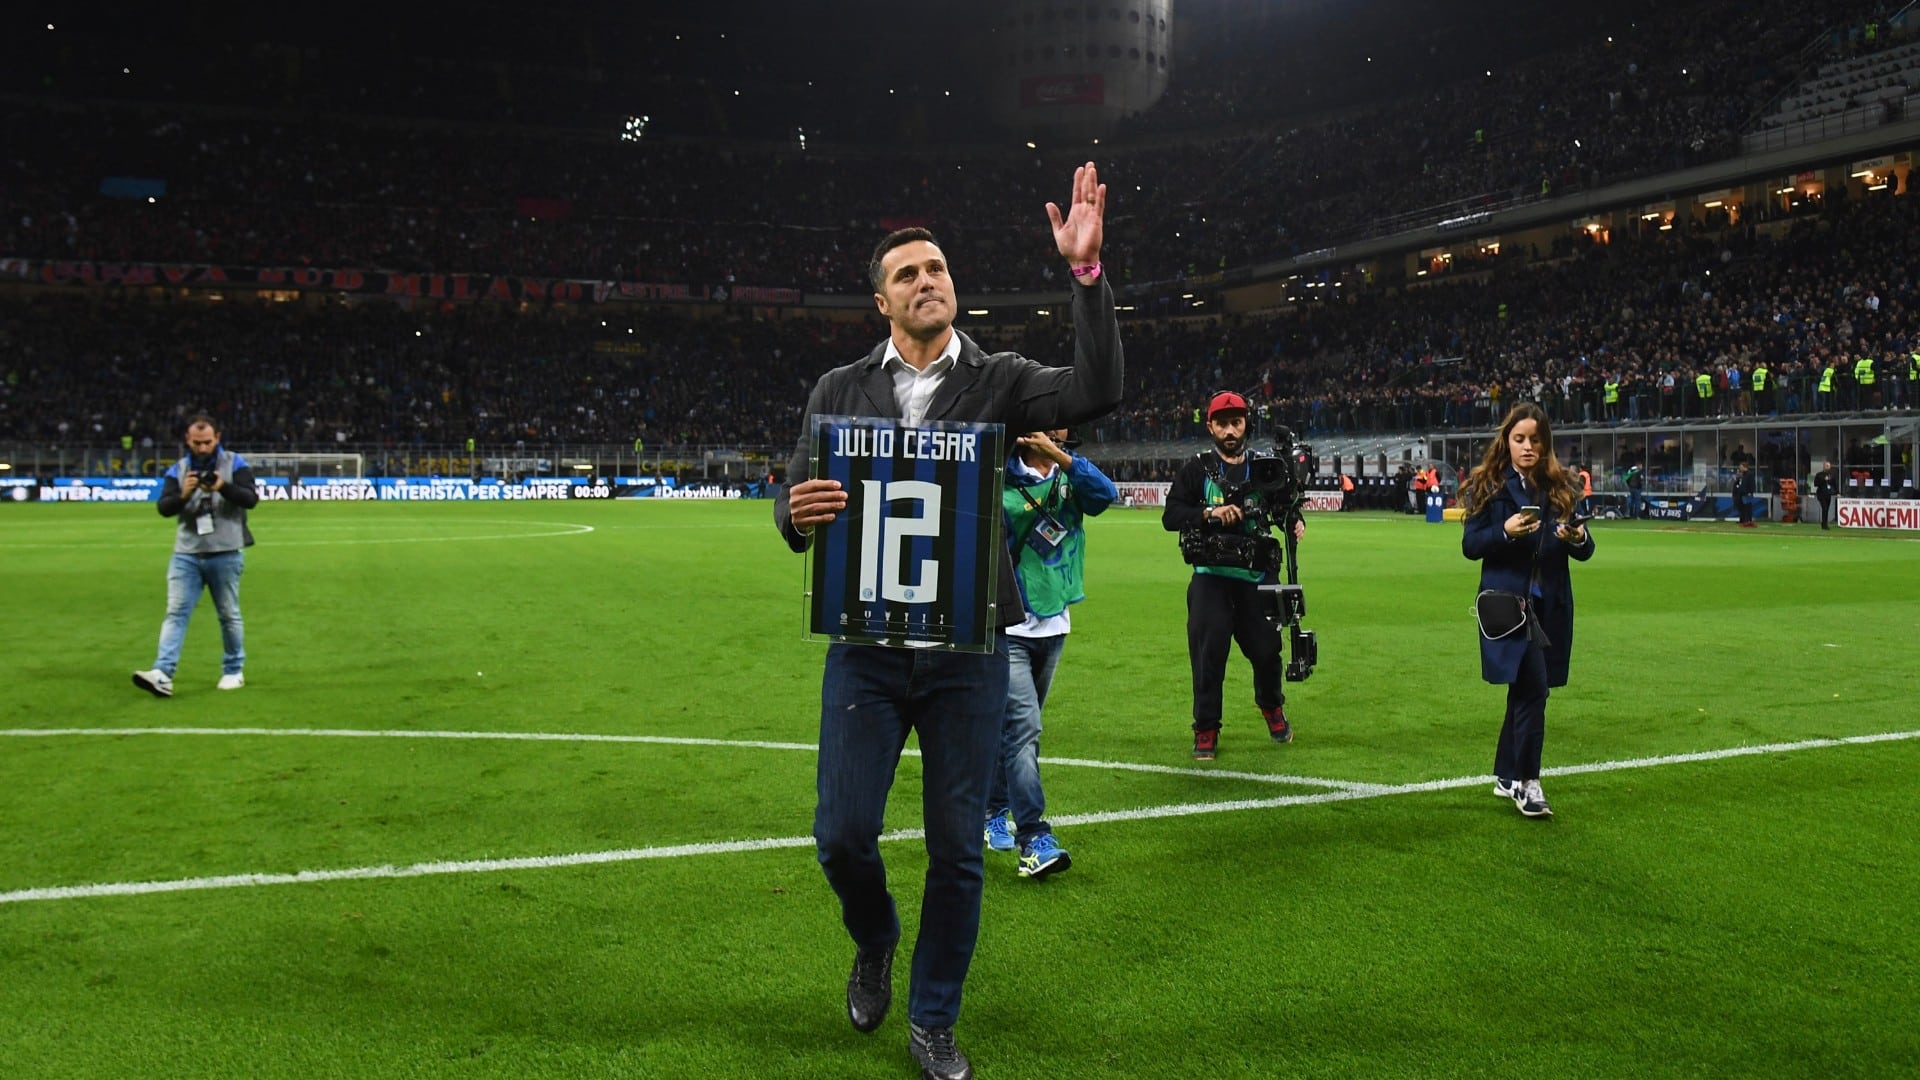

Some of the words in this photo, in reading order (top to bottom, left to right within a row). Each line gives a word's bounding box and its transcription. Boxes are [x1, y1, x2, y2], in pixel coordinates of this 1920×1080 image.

[385, 272, 583, 300] MILANO
[834, 428, 894, 457] JULIO
[904, 430, 976, 462] CESAR
[40, 486, 91, 500] INTER
[92, 486, 151, 500] Forever
[255, 485, 289, 500] LTA
[291, 485, 377, 500] INTERISTA
[381, 485, 465, 500] INTERISTA
[468, 485, 500, 499] PER
[502, 485, 568, 499] SEMPRE
[574, 486, 609, 498] 00:00
[1839, 506, 1920, 528] SANGEMI
[859, 479, 942, 603] 12
